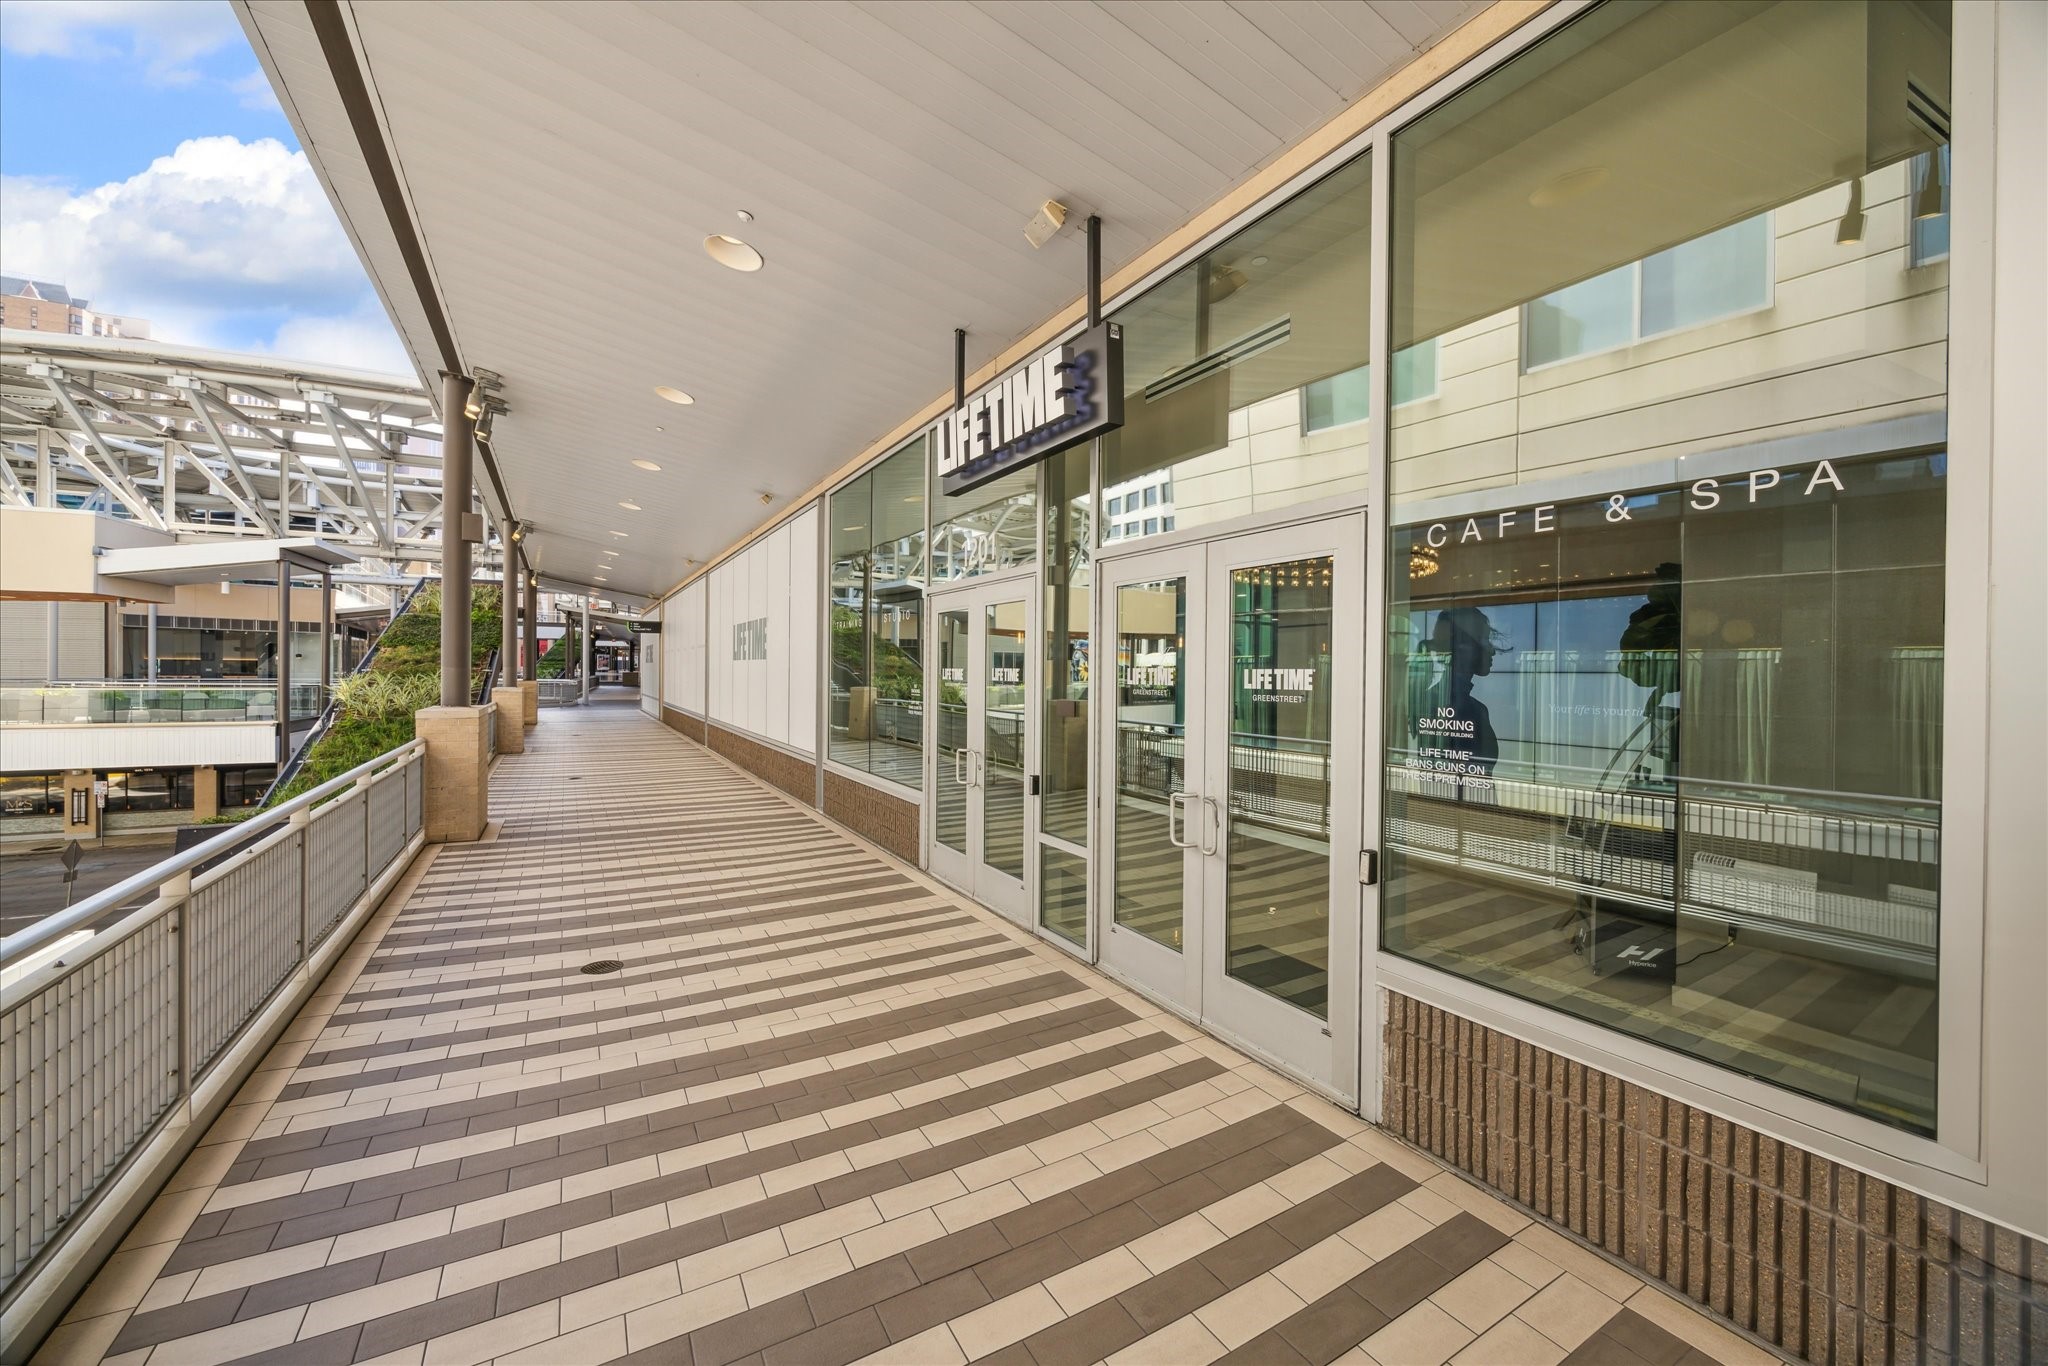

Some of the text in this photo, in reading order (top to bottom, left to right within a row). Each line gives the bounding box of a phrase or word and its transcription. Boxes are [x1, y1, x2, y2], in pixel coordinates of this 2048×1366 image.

[1426, 460, 1845, 548] CAFE & SPA
[961, 533, 995, 567] 1201
[1252, 694, 1303, 703] GREENSTREET
[1437, 707, 1455, 718] NO
[1592, 706, 1601, 715] is
[1419, 718, 1474, 732] SMOKING
[1419, 747, 1441, 758] LIFE
[1405, 758, 1485, 775] BANS GUNS ON
[1402, 771, 1491, 789] THESE PREMISES
[1628, 960, 1657, 968] Hyperice
